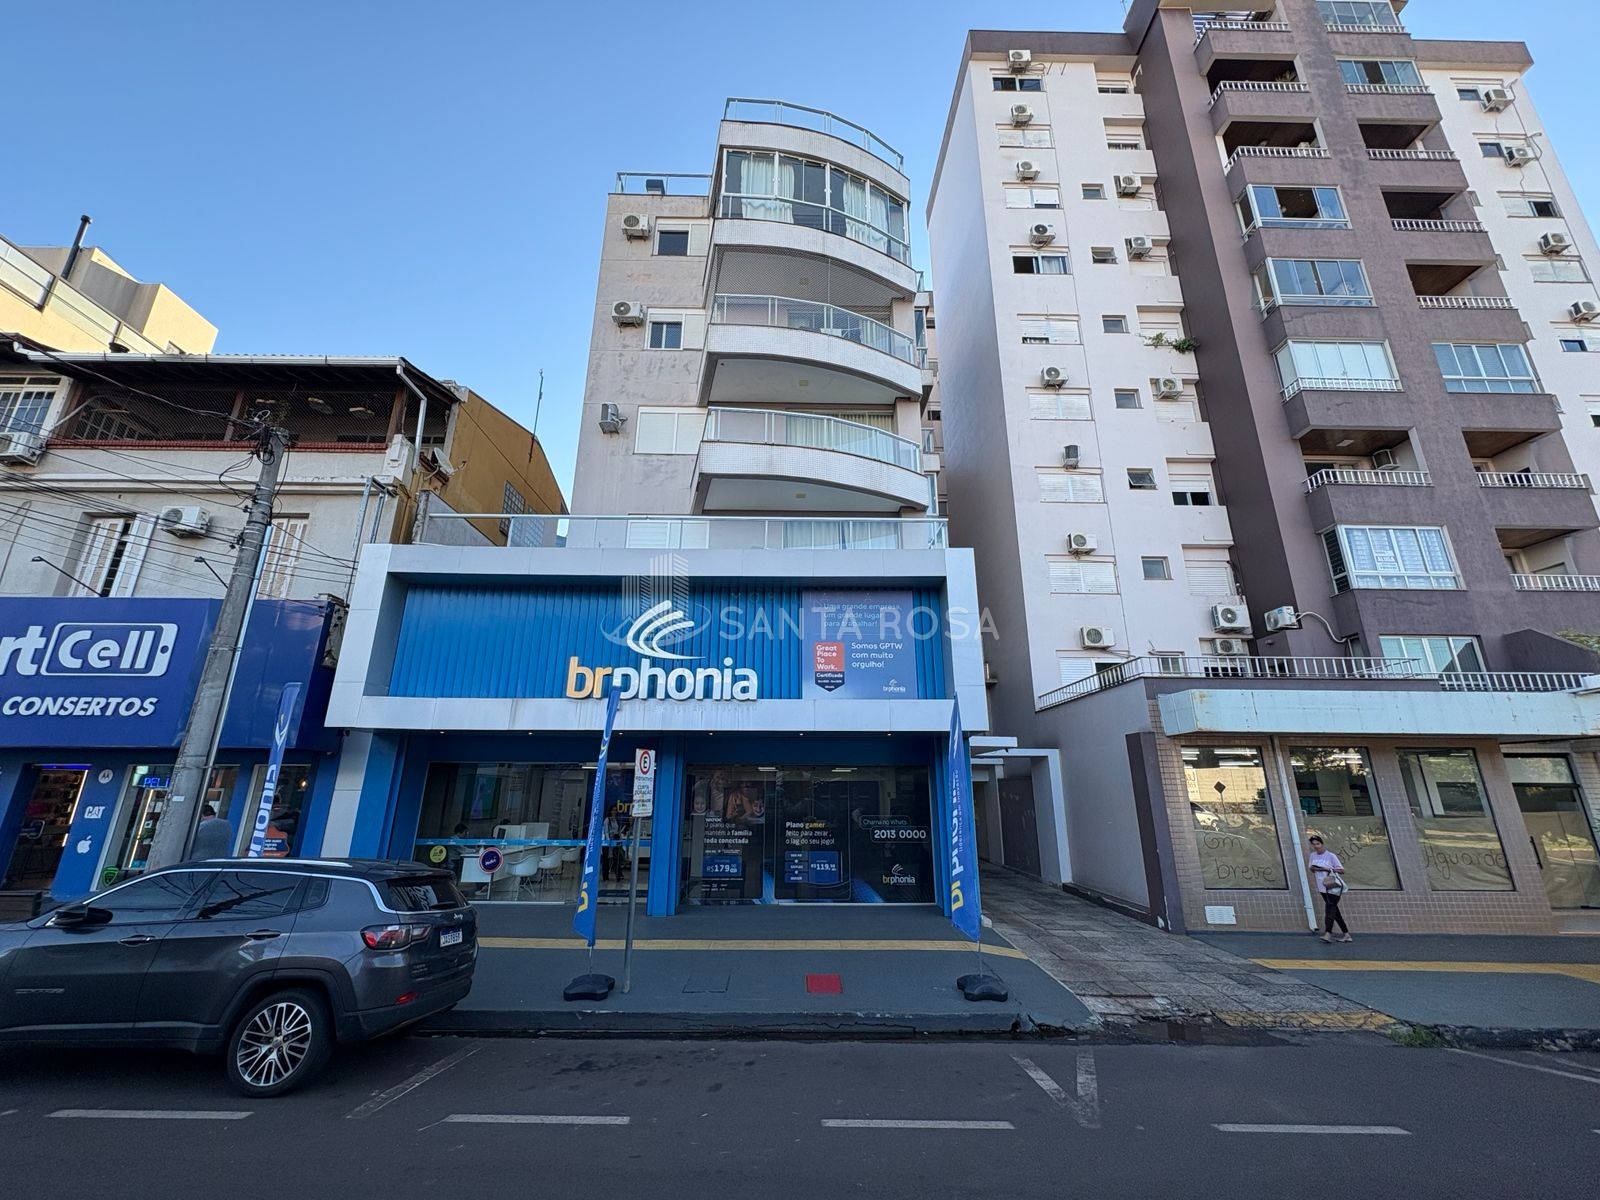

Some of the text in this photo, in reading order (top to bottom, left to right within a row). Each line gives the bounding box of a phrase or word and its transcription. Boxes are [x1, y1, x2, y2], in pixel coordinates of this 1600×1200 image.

[842, 603, 867, 612] grande
[58, 630, 155, 669] Cell
[851, 660, 885, 670] orgulho!
[566, 656, 758, 700] brphonia
[2, 696, 159, 716] CONSERTOS
[84, 806, 105, 819] CAT
[805, 822, 825, 830] gamer
[874, 829, 927, 839] 2013 0000
[1214, 858, 1276, 882] breve
[882, 874, 916, 885] brphonia
